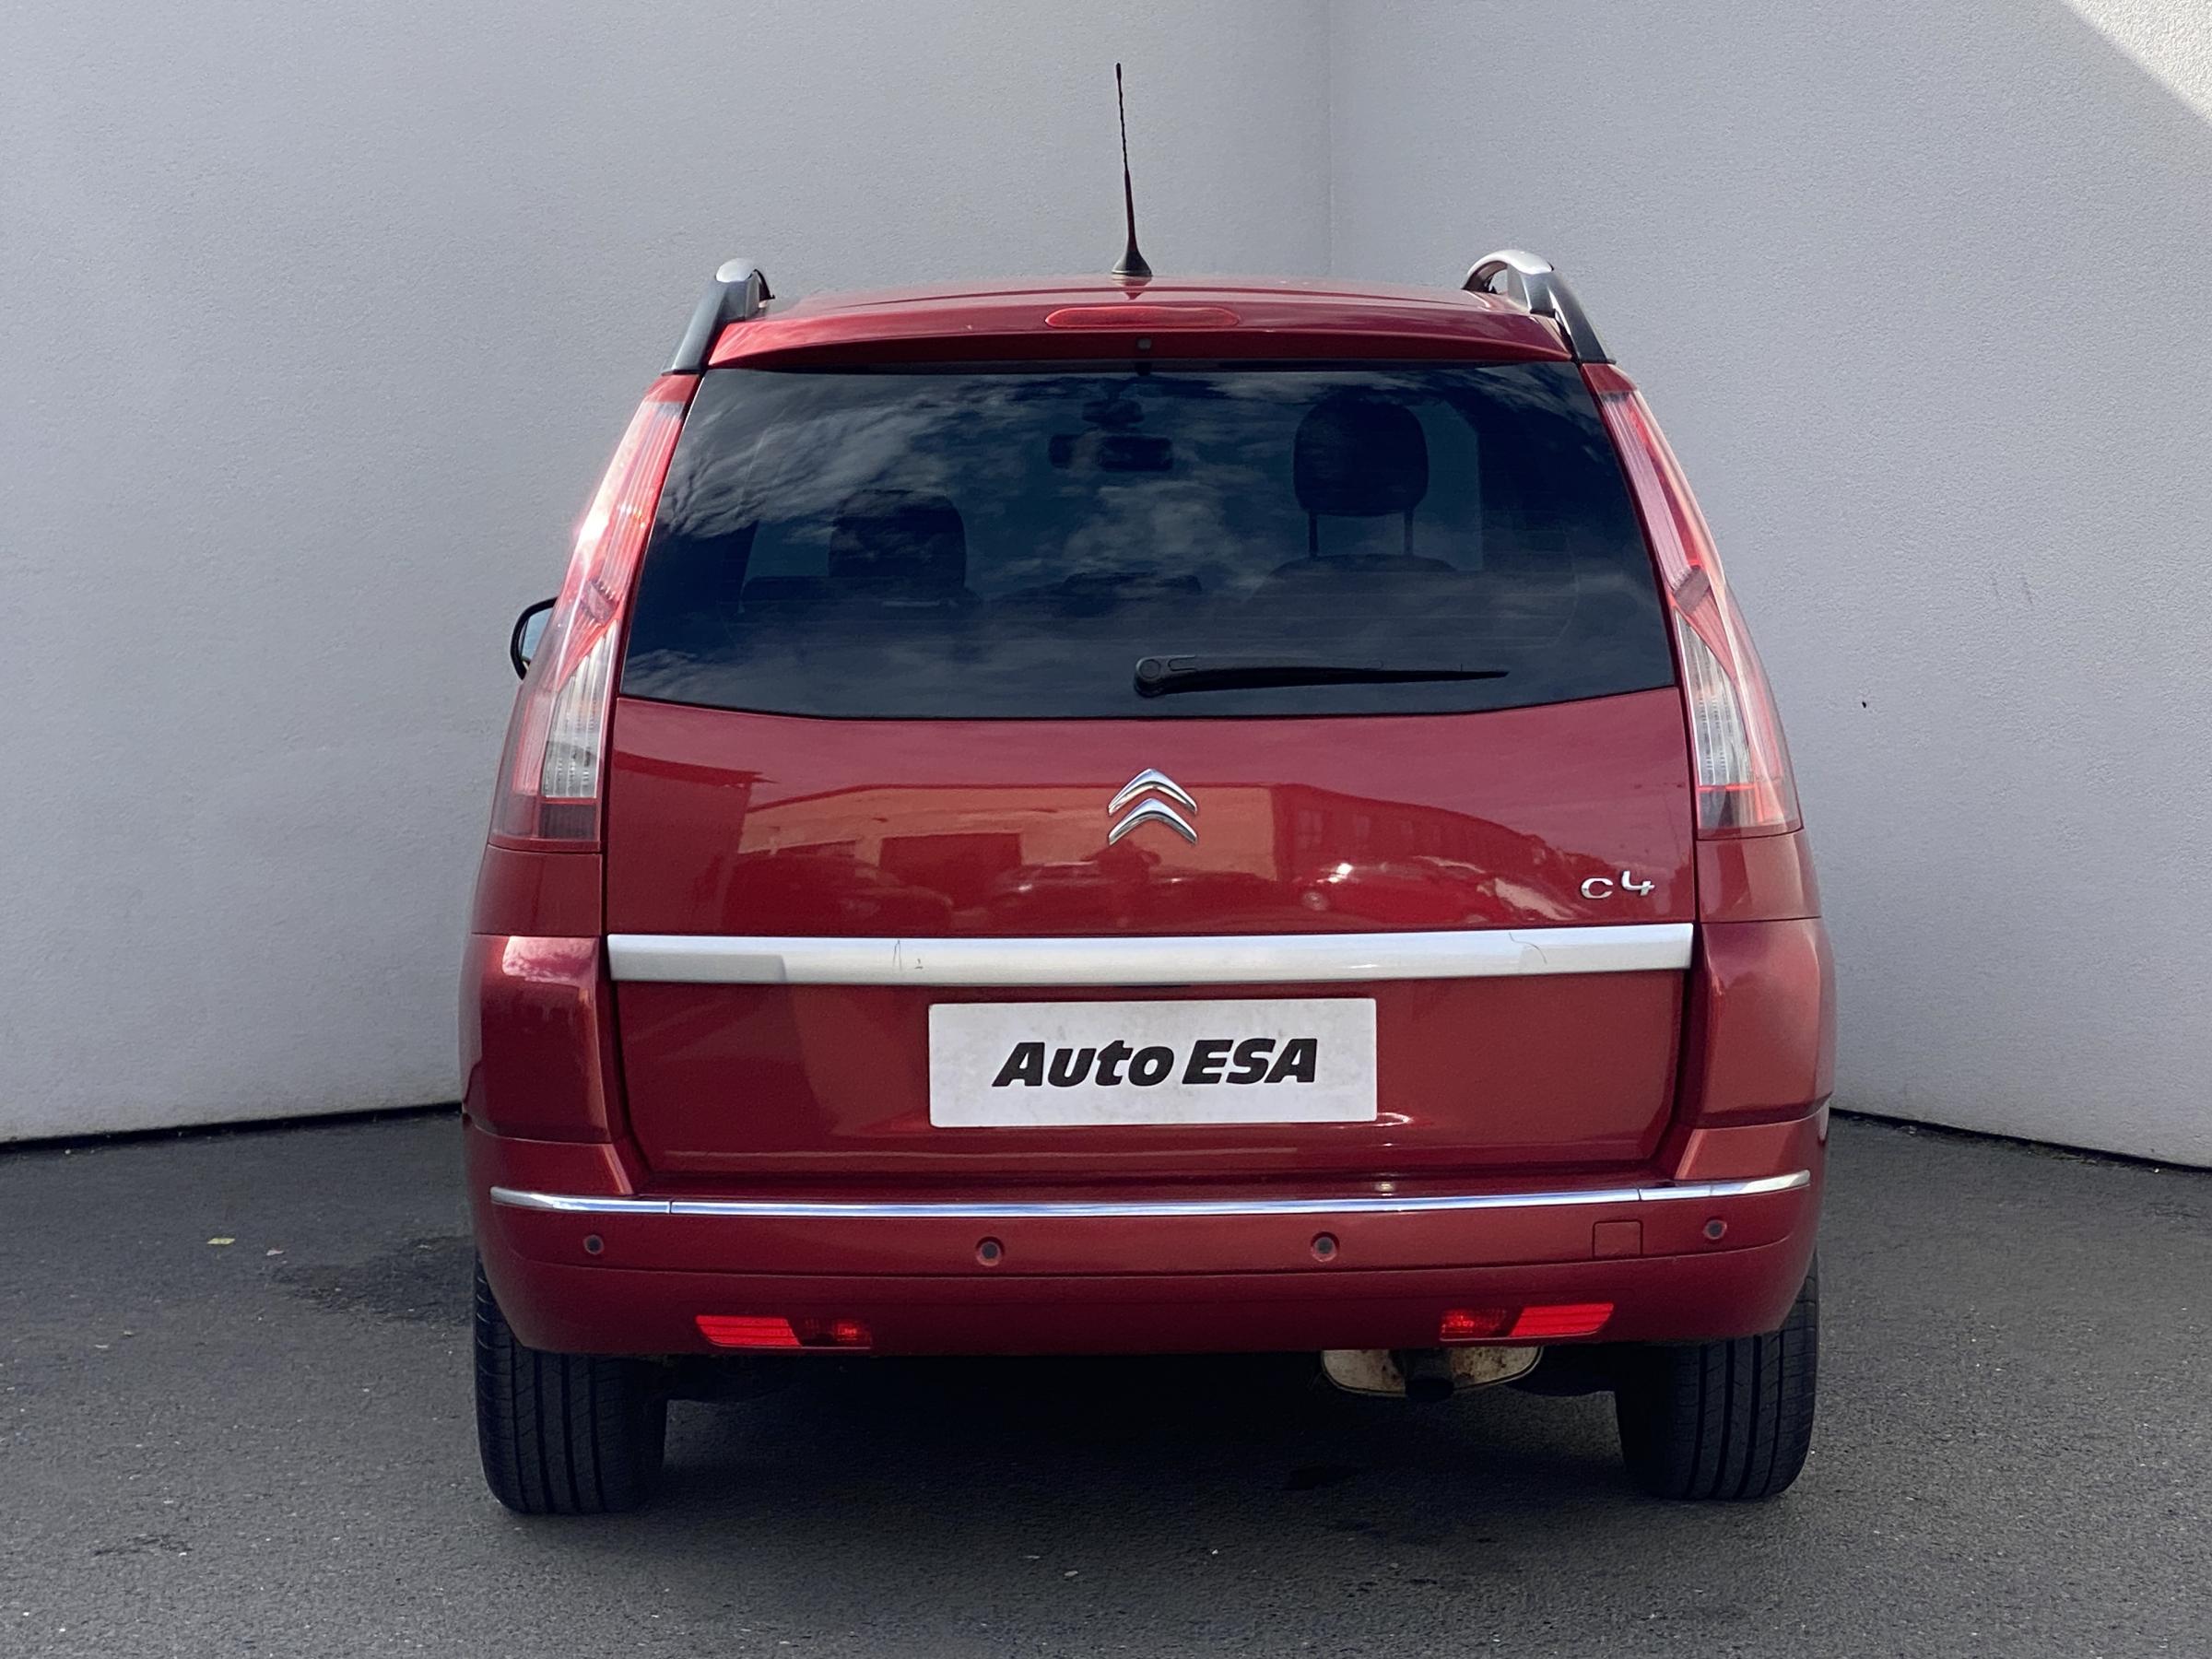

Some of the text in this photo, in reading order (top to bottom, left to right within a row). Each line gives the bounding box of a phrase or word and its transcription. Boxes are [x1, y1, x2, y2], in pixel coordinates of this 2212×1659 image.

[1581, 870, 1655, 899] C4
[991, 1038, 1318, 1088] Auto ESA
